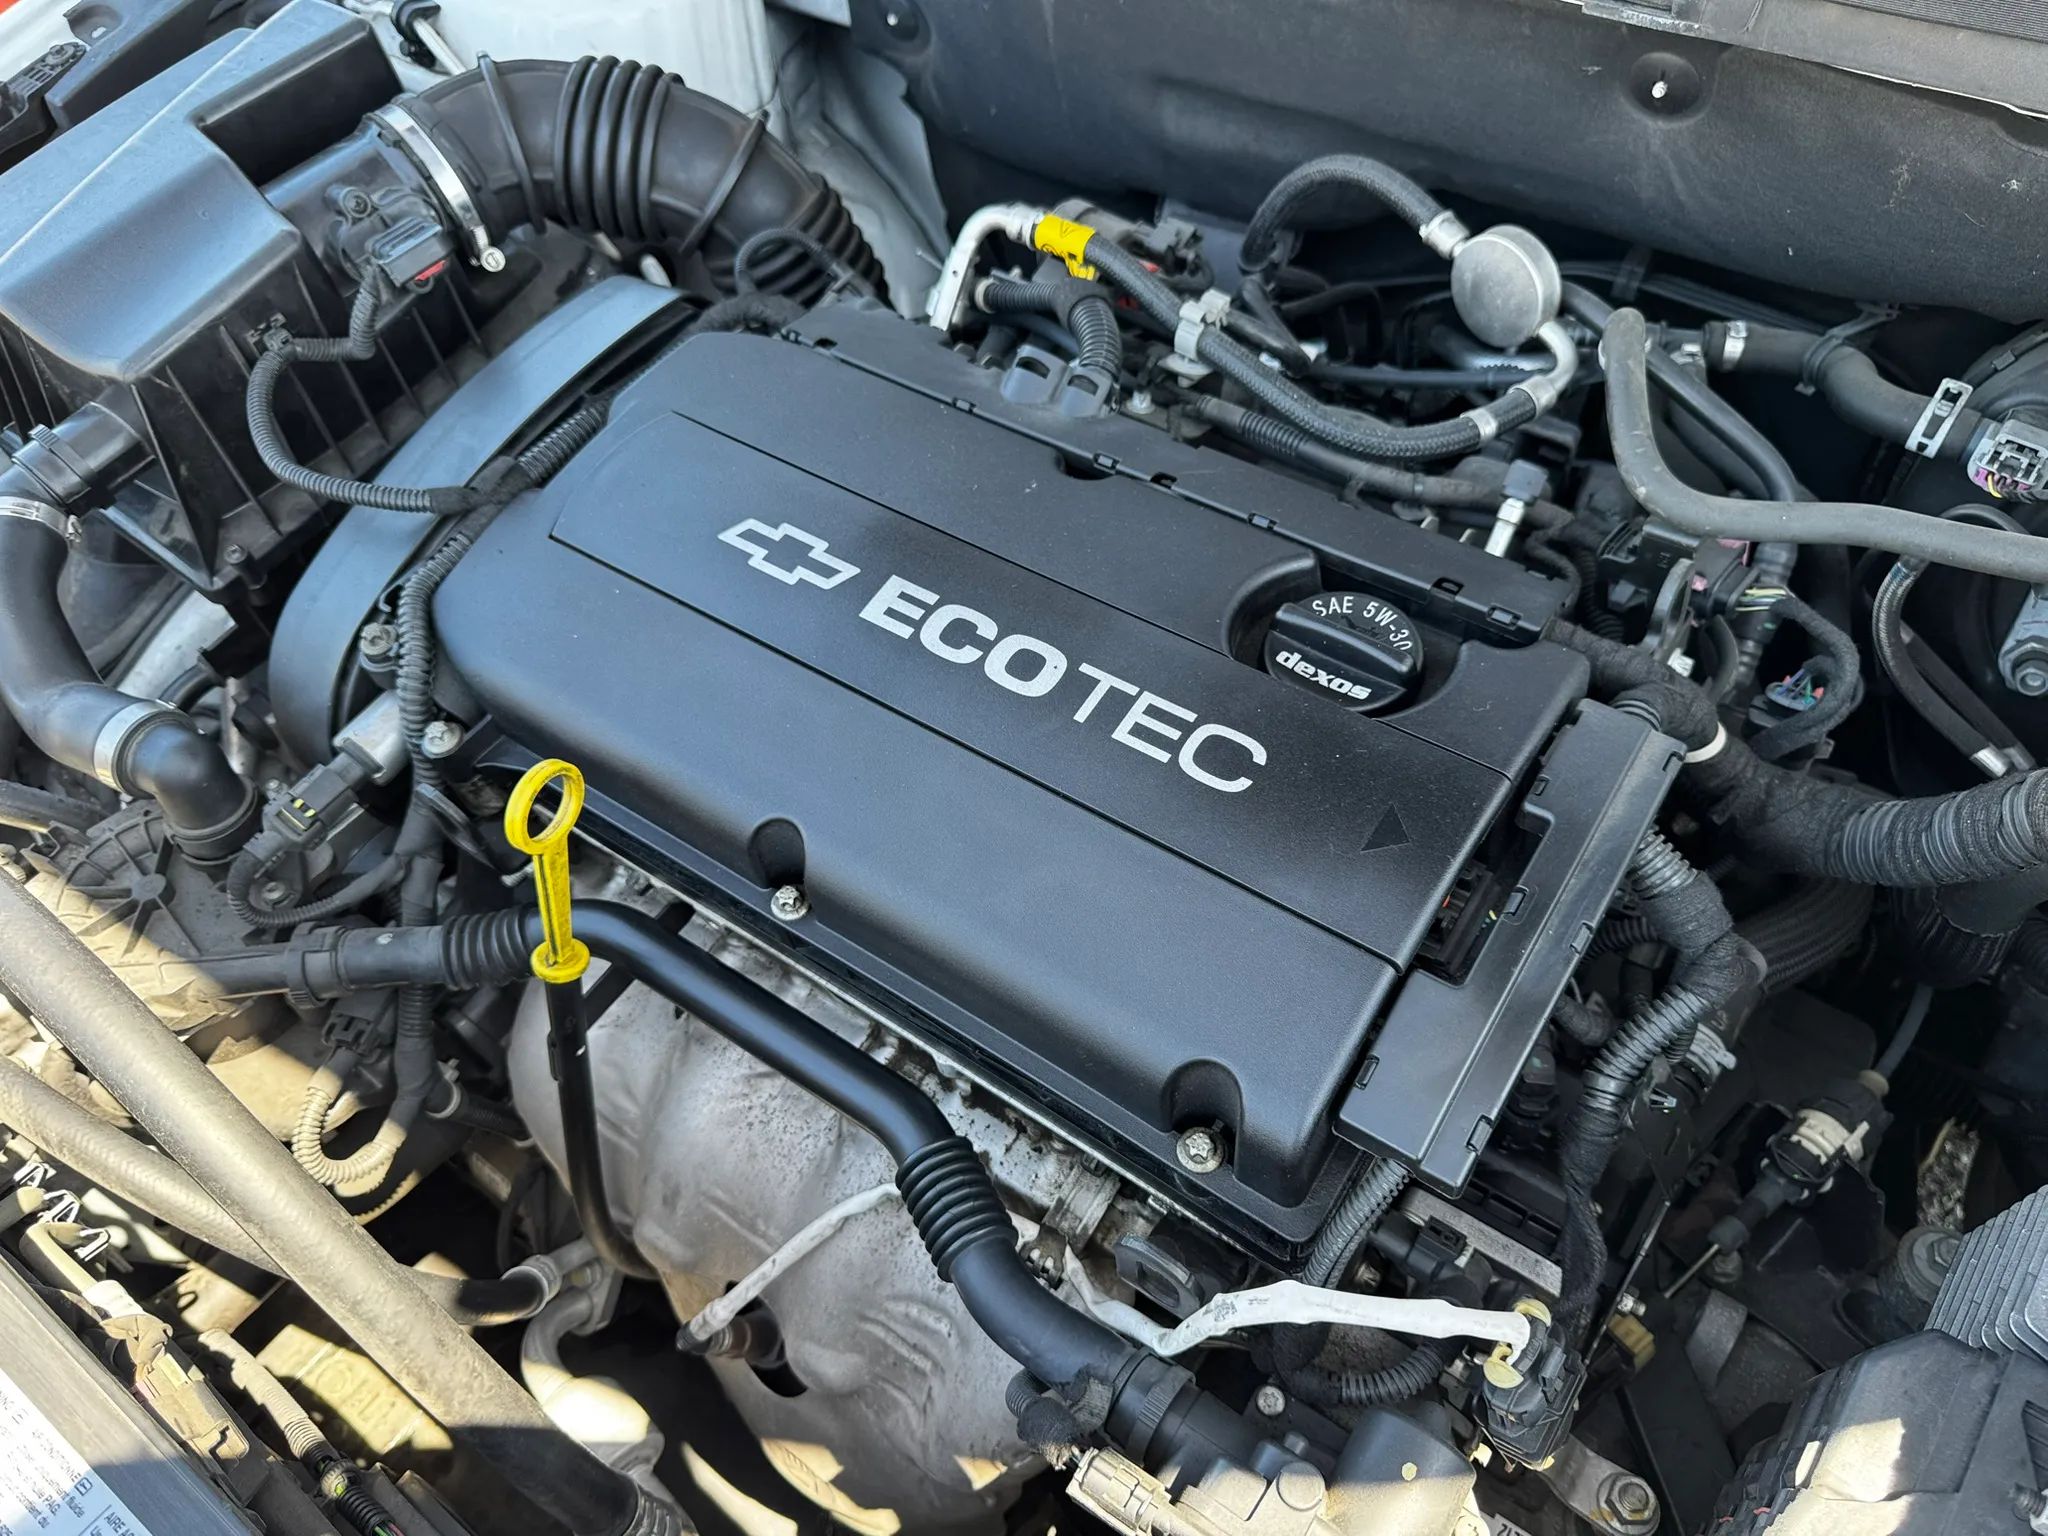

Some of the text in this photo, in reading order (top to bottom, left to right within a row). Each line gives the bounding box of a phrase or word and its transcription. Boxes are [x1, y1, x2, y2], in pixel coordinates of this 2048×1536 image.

[1312, 595, 1414, 651] SAE 5W-30
[858, 574, 1267, 793] ECOTEC
[1275, 650, 1372, 700] dexos
